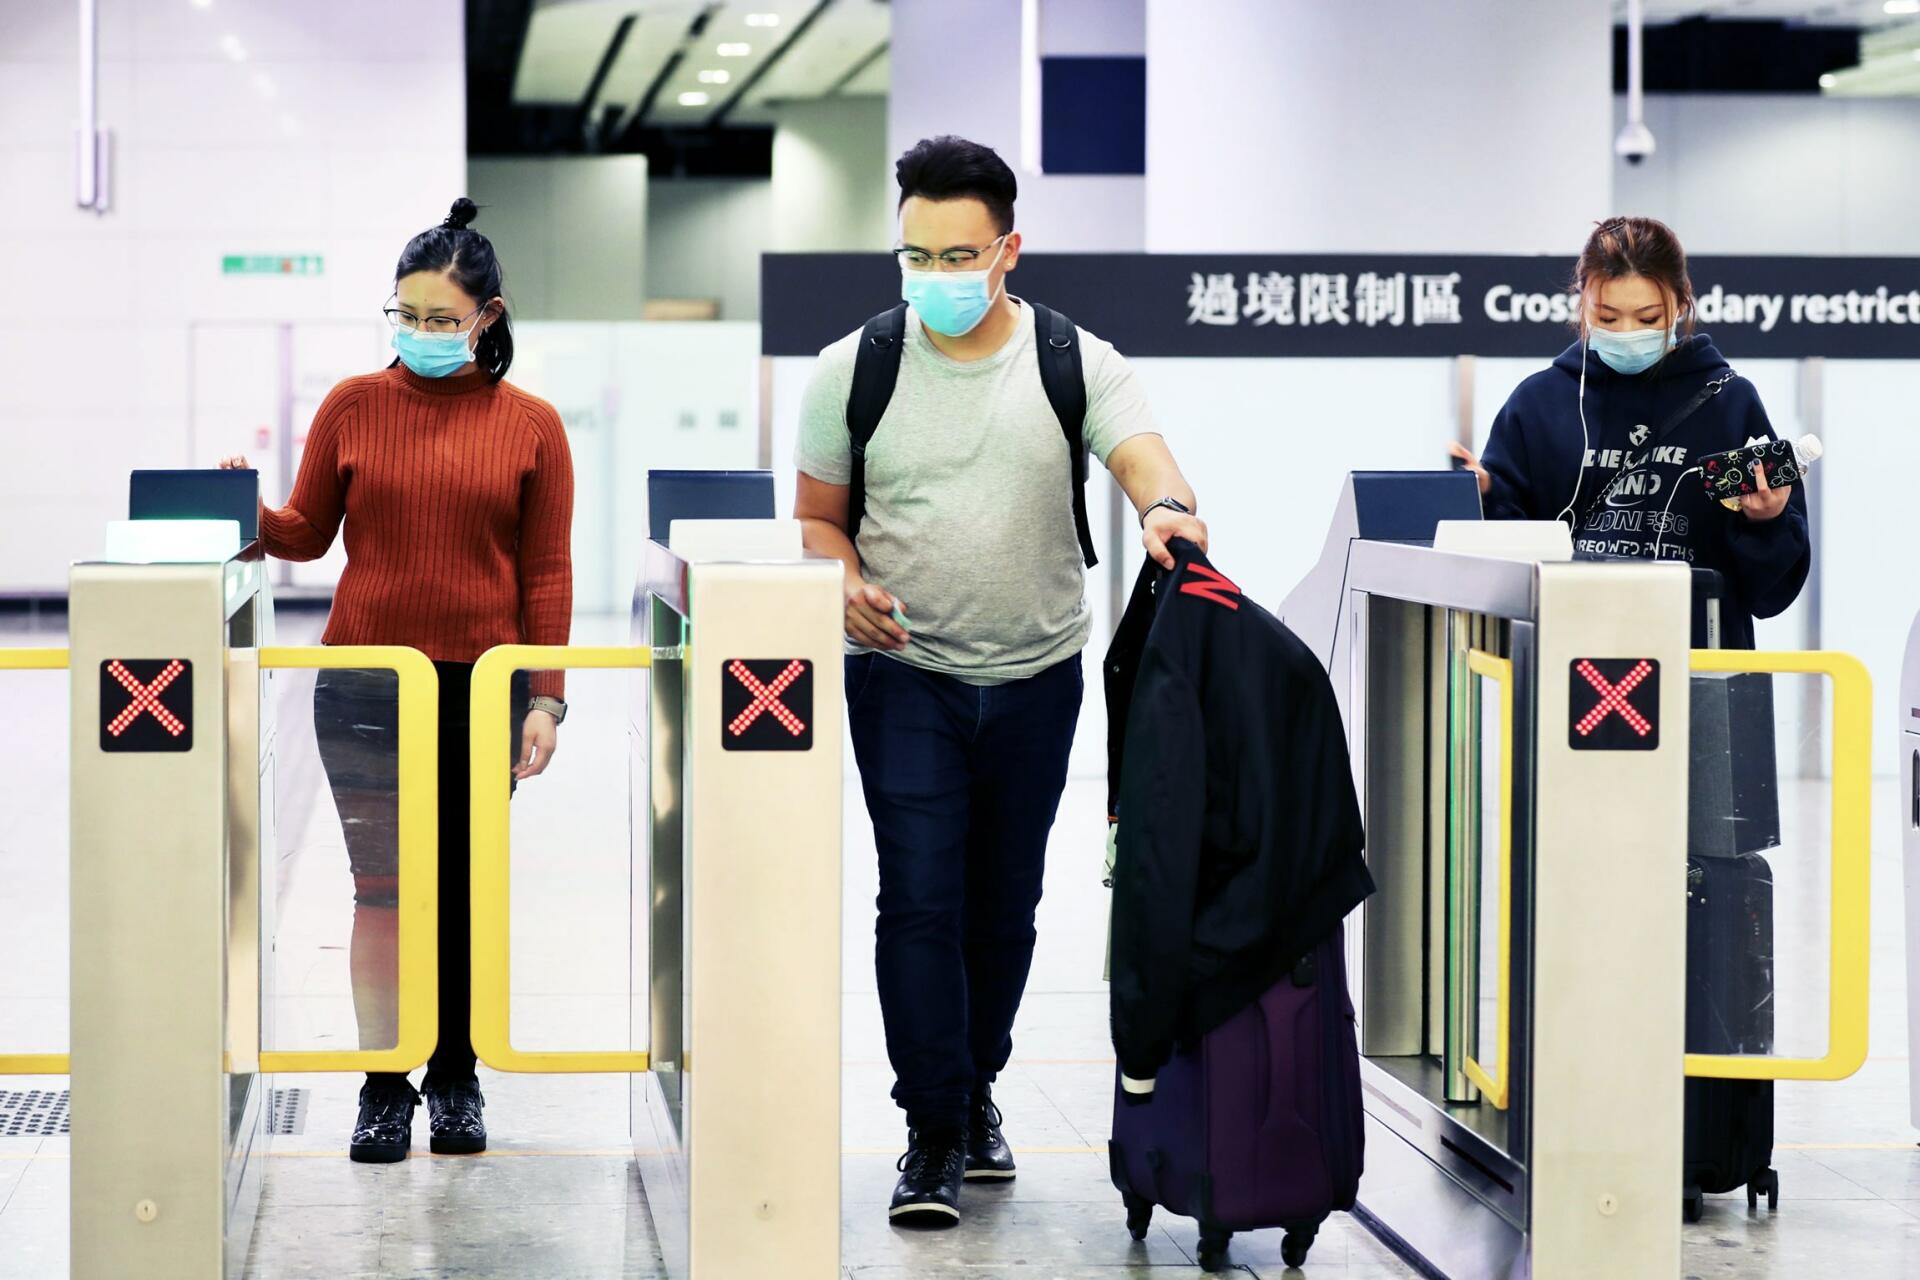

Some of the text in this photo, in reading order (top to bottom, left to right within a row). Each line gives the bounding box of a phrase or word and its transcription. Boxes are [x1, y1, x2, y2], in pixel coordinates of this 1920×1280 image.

[1187, 271, 1463, 326] 過境限制區
